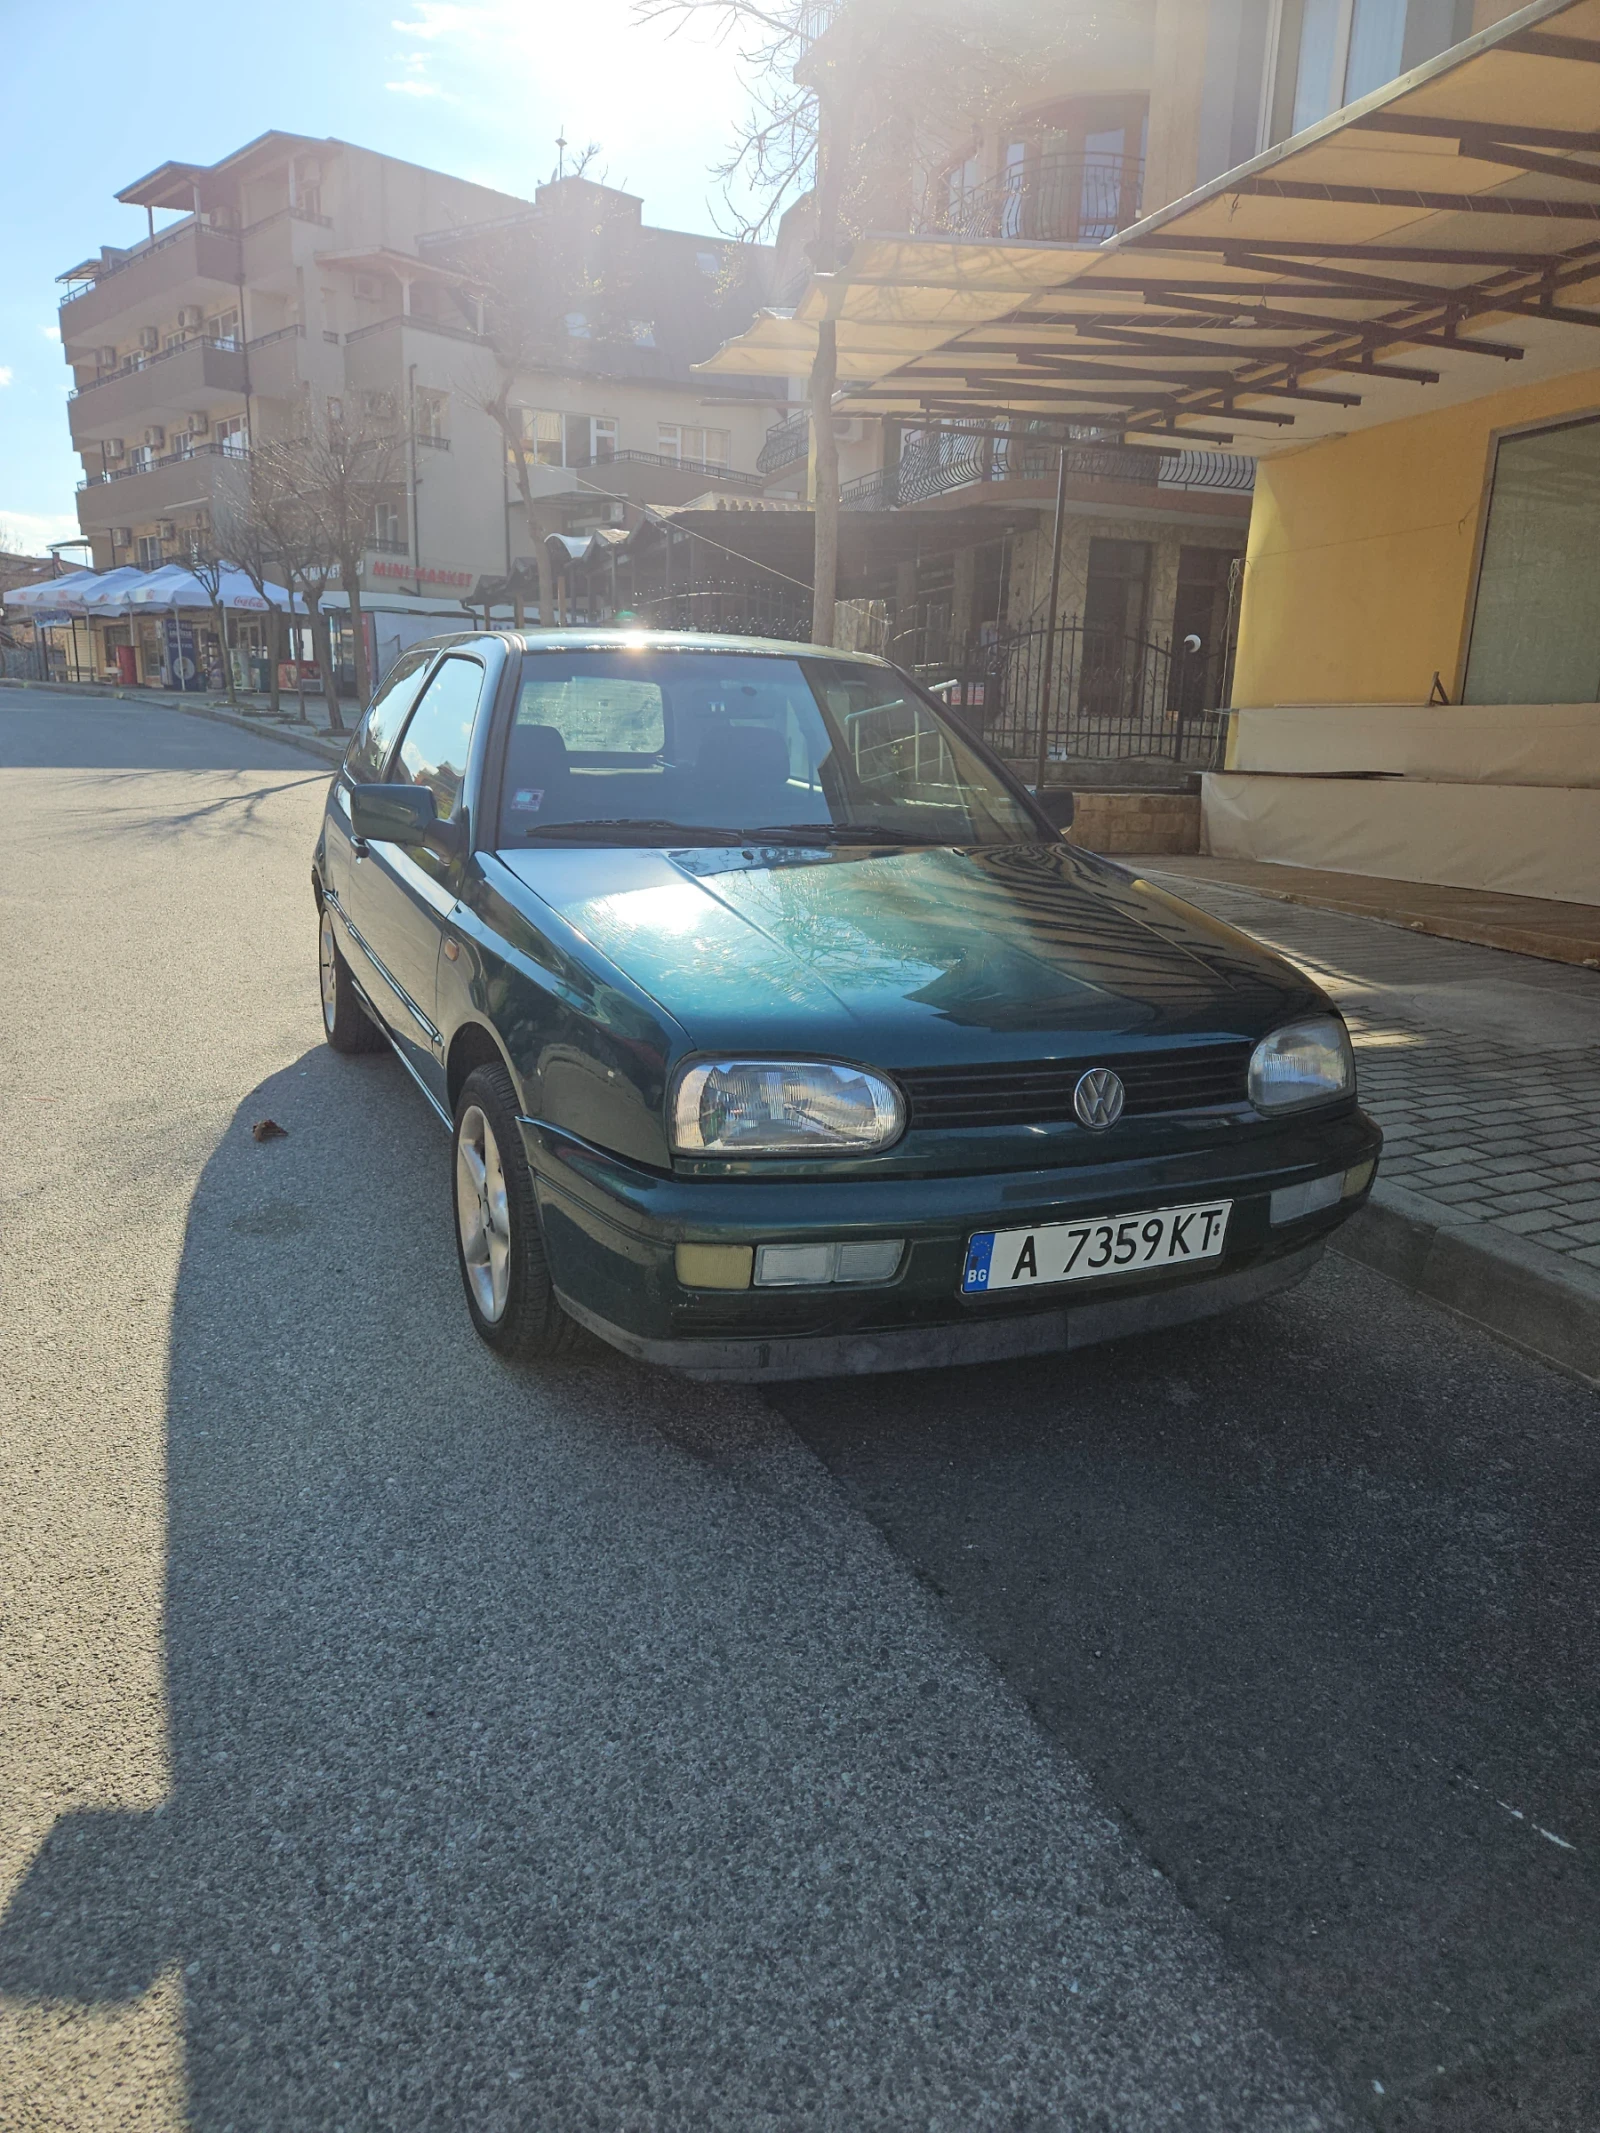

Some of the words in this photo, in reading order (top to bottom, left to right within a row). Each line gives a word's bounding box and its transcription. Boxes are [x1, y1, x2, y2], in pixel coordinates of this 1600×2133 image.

[372, 561, 410, 580] MINI
[414, 567, 473, 587] MARKET
[1011, 1235, 1037, 1280] A
[967, 1269, 987, 1283] BG
